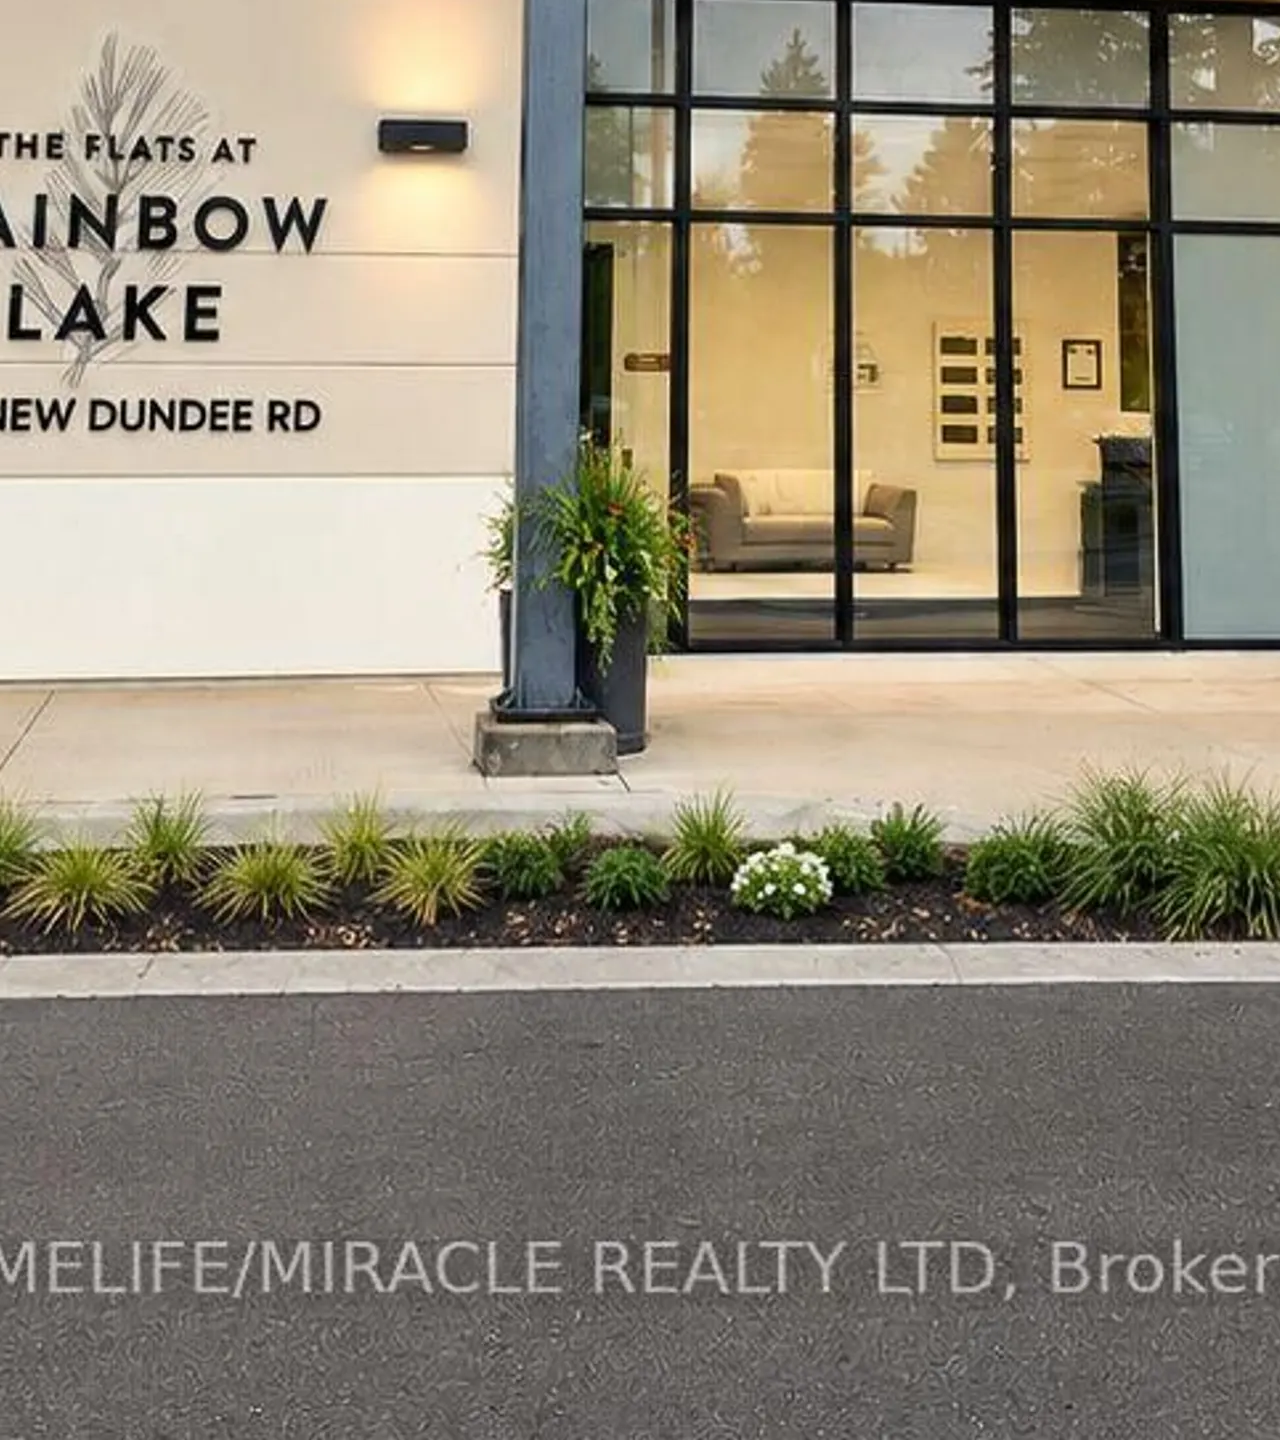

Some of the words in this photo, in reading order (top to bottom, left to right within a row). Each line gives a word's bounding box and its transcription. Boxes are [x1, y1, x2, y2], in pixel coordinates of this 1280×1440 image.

[85, 134, 195, 162] FLATS
[211, 138, 258, 164] AT
[7, 284, 222, 342] LAKE
[88, 399, 253, 432] DUNDEE
[268, 399, 322, 432] RD
